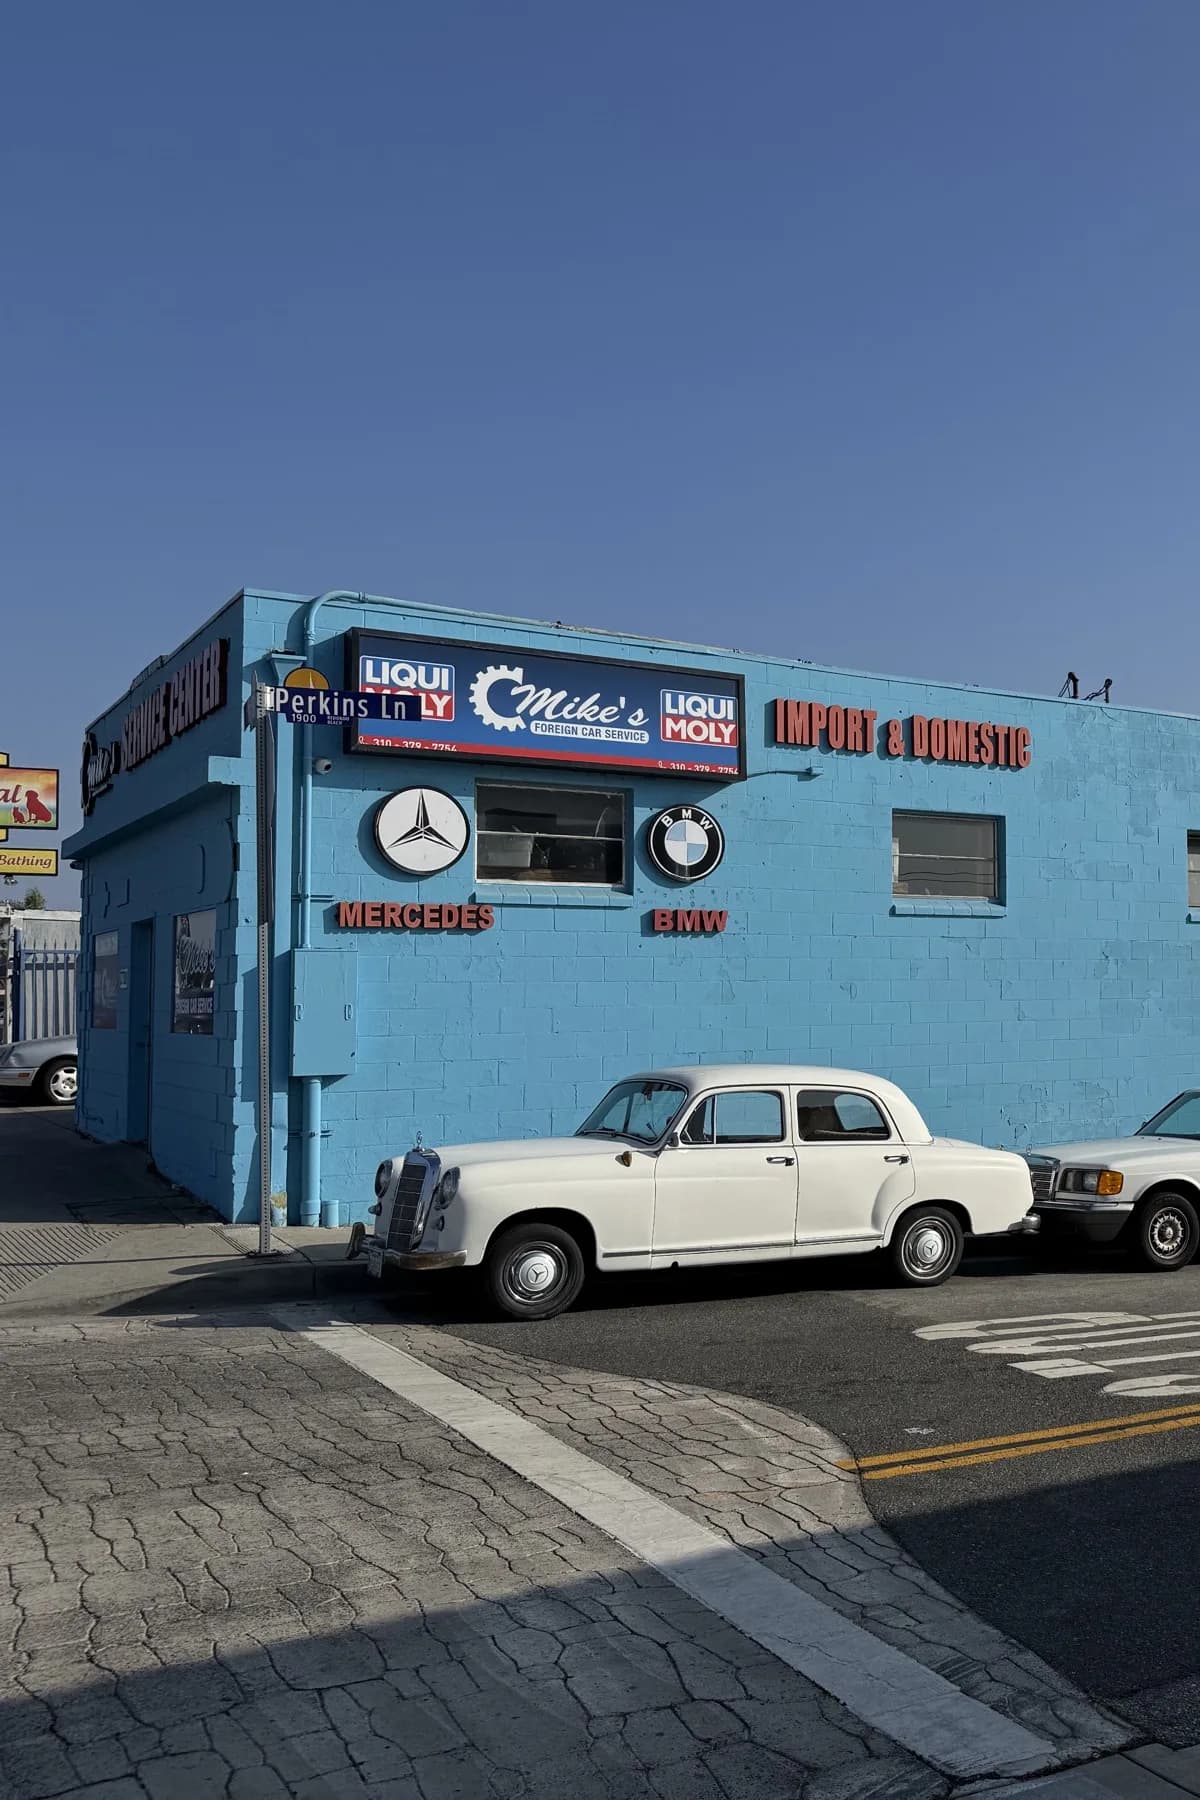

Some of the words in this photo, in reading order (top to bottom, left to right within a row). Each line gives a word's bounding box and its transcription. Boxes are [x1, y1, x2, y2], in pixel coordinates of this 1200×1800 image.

[168, 638, 221, 738] CENTER
[365, 659, 449, 691] LIQUI
[276, 687, 369, 718] Perkins
[381, 694, 406, 720] Ln
[511, 683, 650, 726] Mike's
[665, 692, 734, 720] LIQUI
[120, 681, 166, 771] SERVICE
[291, 713, 317, 723] 1900
[665, 716, 736, 744] MOLY
[372, 738, 392, 747] 310
[534, 722, 578, 737] FOREIGN
[581, 726, 602, 739] CAR
[604, 729, 646, 743] SERVICE
[776, 697, 877, 753] IMPORT
[888, 718, 905, 757] &
[912, 714, 1032, 768] DOMESTIC
[670, 763, 686, 771] 310
[660, 808, 713, 830] BMW
[0, 854, 52, 869] Bathing
[339, 902, 495, 930] MERCEDES
[655, 909, 729, 932] BMW
